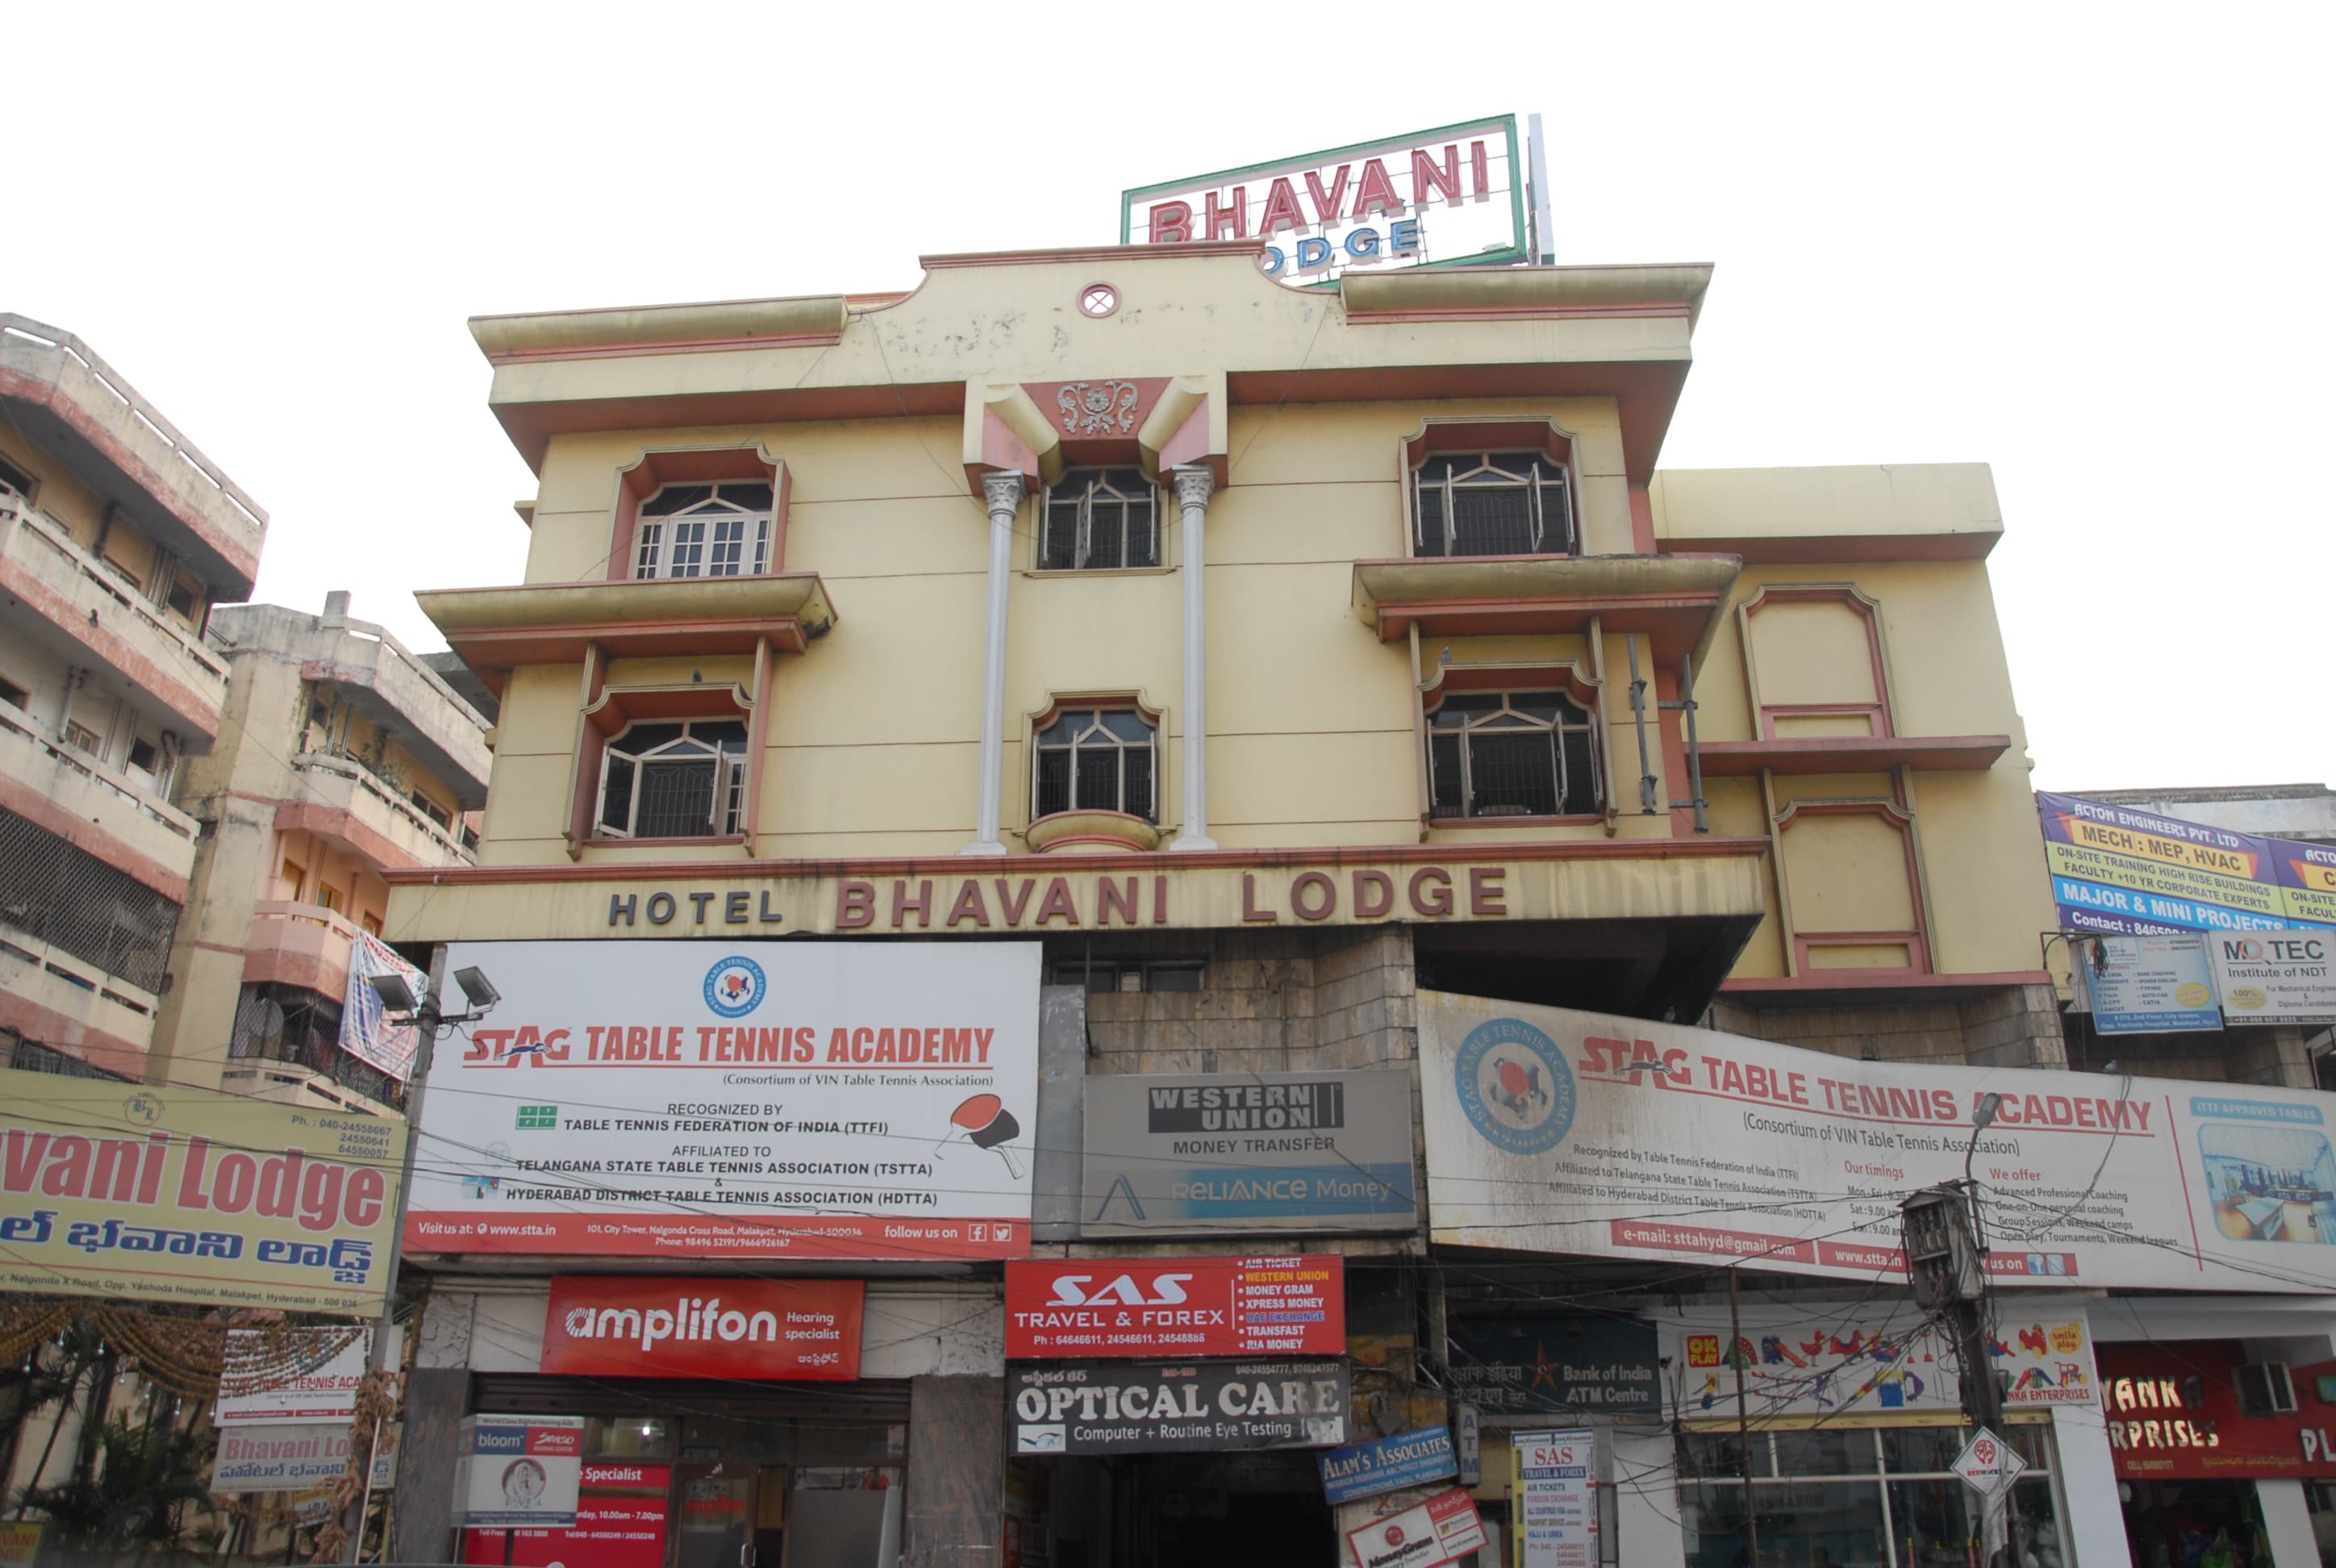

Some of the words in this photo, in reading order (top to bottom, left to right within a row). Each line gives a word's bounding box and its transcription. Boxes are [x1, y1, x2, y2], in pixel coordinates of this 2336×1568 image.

[1149, 140, 1489, 244] BHAVANI
[1266, 219, 1421, 275] ODGE
[2074, 803, 2115, 822] ACTON
[2118, 811, 2187, 837] ENGINEERS
[2188, 827, 2214, 844] PVT.
[2217, 833, 2239, 848] LTD
[2081, 825, 2134, 849] MECH
[2193, 848, 2241, 871] HVAC
[2305, 849, 2336, 863] ACTO
[2057, 846, 2101, 864] ON-SITE
[2103, 855, 2156, 874] TRAINING
[2159, 866, 2185, 879] HIGH
[2188, 872, 2212, 887] RISE
[2214, 878, 2271, 897] BUILDINGS
[2063, 861, 2114, 880] FACULTY
[2138, 874, 2155, 887] YR
[2157, 879, 2224, 901] CORPORATE
[2223, 892, 2271, 910] EXPERTS
[608, 890, 782, 926] HOTEL
[835, 874, 1167, 929] BHAVANI
[1242, 866, 1507, 921] LODGE
[2063, 882, 2130, 911] MAJOR
[2134, 895, 2147, 914] &
[2150, 899, 2193, 922] MINI
[2291, 890, 2335, 906] ON-SITE
[2299, 905, 2336, 919] FACUL
[2071, 911, 2125, 932] Contact
[2228, 968, 2280, 978] Institute
[2301, 967, 2328, 978] NDT
[463, 1025, 571, 1068] STAG
[586, 1025, 684, 1061] TABLE
[697, 1026, 816, 1062] TENNIS
[826, 1027, 995, 1064] ACADEMY
[723, 1073, 795, 1086] (Consortium
[799, 1074, 811, 1085] of
[816, 1074, 838, 1085] VIN
[843, 1074, 876, 1086] Table
[878, 1074, 918, 1086] Tennis
[921, 1074, 994, 1087] Association)
[1579, 1036, 1692, 1089] STAG
[1700, 1054, 1809, 1105] TABLE
[1817, 1077, 1958, 1120] TENNIS
[1151, 1085, 1310, 1110] WESTERN
[667, 1103, 760, 1116] RECOGNIZED
[763, 1103, 783, 1116] BY
[2222, 1103, 2276, 1117] APPROVED
[1201, 1107, 1311, 1131] UNION
[565, 1120, 610, 1131] TABLE
[615, 1120, 670, 1132] TENNIS
[674, 1120, 769, 1132] FEDERATION
[774, 1121, 794, 1132] OF
[798, 1122, 840, 1133] INDIA
[845, 1122, 889, 1136] (TTFI)
[1743, 1111, 1816, 1140] (Consortium
[1833, 1127, 1858, 1145] VIN
[1859, 1130, 1894, 1149] Table
[1896, 1134, 1939, 1151] Tennis
[1942, 1136, 2021, 1157] Association)
[672, 1145, 749, 1157] AFFILIATED
[753, 1145, 772, 1157] TO
[1174, 1139, 1237, 1155] MONEY
[1243, 1136, 1335, 1153] TRANSFER
[1574, 1143, 1629, 1161] Recognized
[1644, 1150, 1669, 1164] Table
[1671, 1154, 1699, 1168] Tennis
[1700, 1157, 1745, 1174] Federation
[516, 1159, 602, 1172] TELANGANA
[607, 1161, 653, 1173] STATE
[657, 1161, 704, 1174] TABLE
[709, 1161, 764, 1174] TENNIS
[767, 1162, 870, 1175] ASSOCIATION
[874, 1163, 933, 1178] (TSTTA)
[1554, 1162, 1600, 1178] Affiliated
[1614, 1167, 1662, 1185] Telangana
[1663, 1173, 1687, 1186] State
[1844, 1160, 1863, 1175] Our
[1865, 1163, 1904, 1182] timings
[1989, 1168, 2009, 1181] We
[2012, 1168, 2042, 1182] offer
[0, 1129, 171, 1204] vani
[177, 1135, 386, 1232] Lodge
[506, 1188, 591, 1201] HYDERABAD
[667, 1190, 711, 1203] TABLE
[715, 1191, 770, 1203] TENNIS
[774, 1191, 874, 1205] ASSOCIATION
[878, 1192, 938, 1207] (HDTTA)
[1316, 1178, 1392, 1202] Money
[1608, 1188, 1659, 1203] Hyderabad
[1661, 1191, 1693, 1206] District
[1993, 1186, 2036, 1197] Advanced
[2037, 1186, 2089, 1199] Professional
[490, 1223, 557, 1236] www.stta.in
[649, 1225, 687, 1236] Nalgonda
[688, 1226, 711, 1236] Cross
[884, 1224, 921, 1238] follow
[1623, 1230, 1672, 1245] e-mail:
[1264, 1257, 1302, 1269] TICKET
[1835, 1249, 1902, 1267] www.stta.in
[1245, 1271, 1294, 1282] WESTERN
[1296, 1270, 1329, 1281] UNION
[1045, 1273, 1194, 1307] SAS
[1245, 1285, 1282, 1295] MONEY
[1283, 1284, 1314, 1295] GRAM
[1245, 1298, 1286, 1309] XPRESS
[1287, 1297, 1324, 1308] MONEY
[565, 1297, 778, 1352] amplifon
[786, 1312, 835, 1325] Hearing
[1014, 1312, 1106, 1328] TRAVEL
[1115, 1311, 1132, 1327] &
[1142, 1310, 1224, 1326] FOREX
[1245, 1312, 1267, 1323] UAE
[785, 1328, 841, 1342] specialist
[1245, 1325, 1305, 1337] TRANSFAST
[1246, 1339, 1265, 1349] RIA
[1266, 1338, 1304, 1349] MONEY
[1690, 1338, 1717, 1354] OK
[1690, 1353, 1717, 1364] PLAY
[1563, 1365, 1600, 1381] Bank
[1618, 1365, 1653, 1381] India
[1016, 1384, 1209, 1422] OPTICAL
[1218, 1380, 1341, 1416] CARE
[1566, 1387, 1602, 1403] ATM
[1604, 1387, 1649, 1403] Centre
[2029, 1388, 2091, 1401] ENTERPRISES
[2100, 1374, 2204, 1412] YANKA
[478, 1432, 521, 1448] bloom
[1074, 1425, 1141, 1442] Computer
[1160, 1423, 1212, 1439] Routine
[1215, 1423, 1239, 1439] Eye
[1241, 1421, 1291, 1440] Testing
[2109, 1420, 2219, 1451] RPRISES
[225, 1436, 319, 1461] Bhavani
[1534, 1446, 1573, 1466] SAS
[585, 1467, 642, 1483] Specialist
[1525, 1469, 1552, 1478] TRAVEL
[1560, 1467, 1585, 1478] FOREX
[1539, 1483, 1566, 1491] TICKETS
